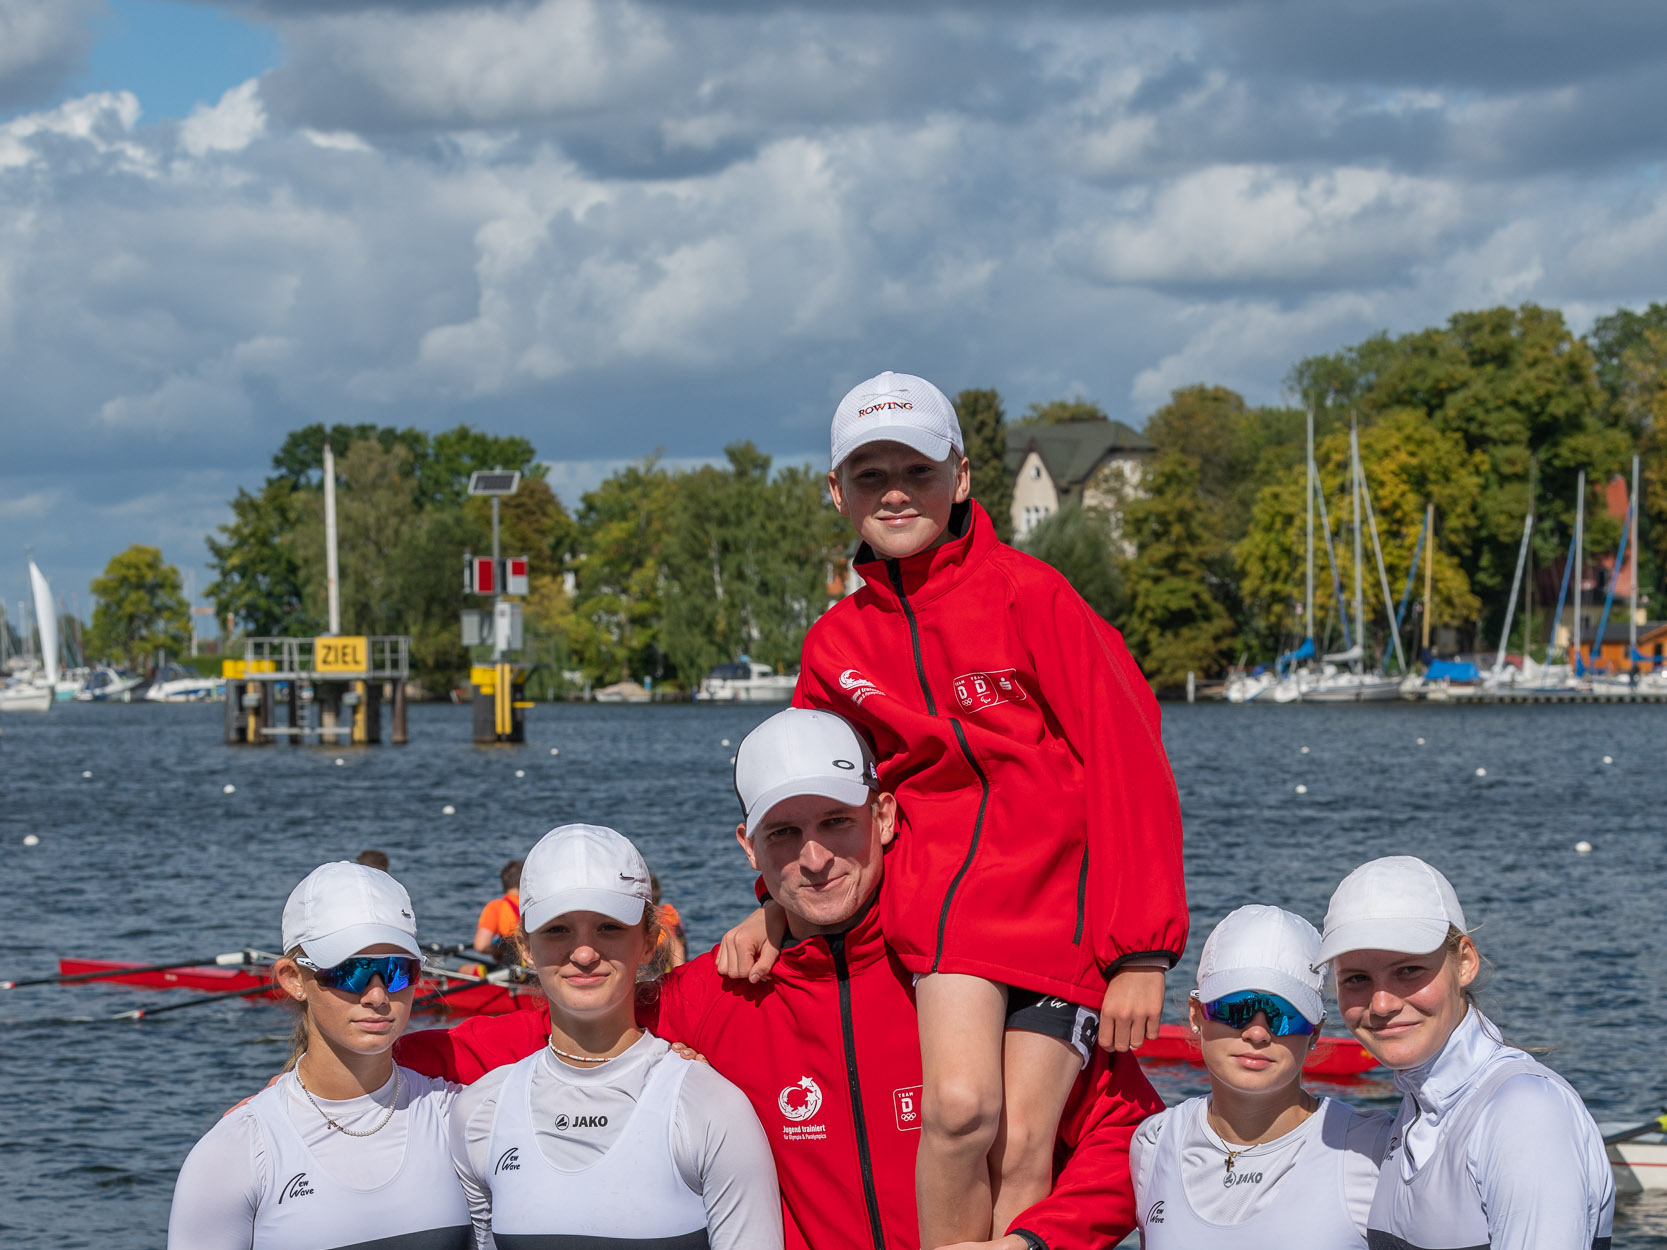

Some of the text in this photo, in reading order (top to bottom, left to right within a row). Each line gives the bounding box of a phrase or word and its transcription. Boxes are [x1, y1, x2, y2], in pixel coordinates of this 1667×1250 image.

[858, 402, 914, 418] ROWING
[321, 644, 362, 665] ZIEL
[901, 1097, 913, 1113] D
[572, 1115, 609, 1128] JAKO
[783, 1125, 801, 1134] Jugend
[1236, 1172, 1263, 1186] JAKO
